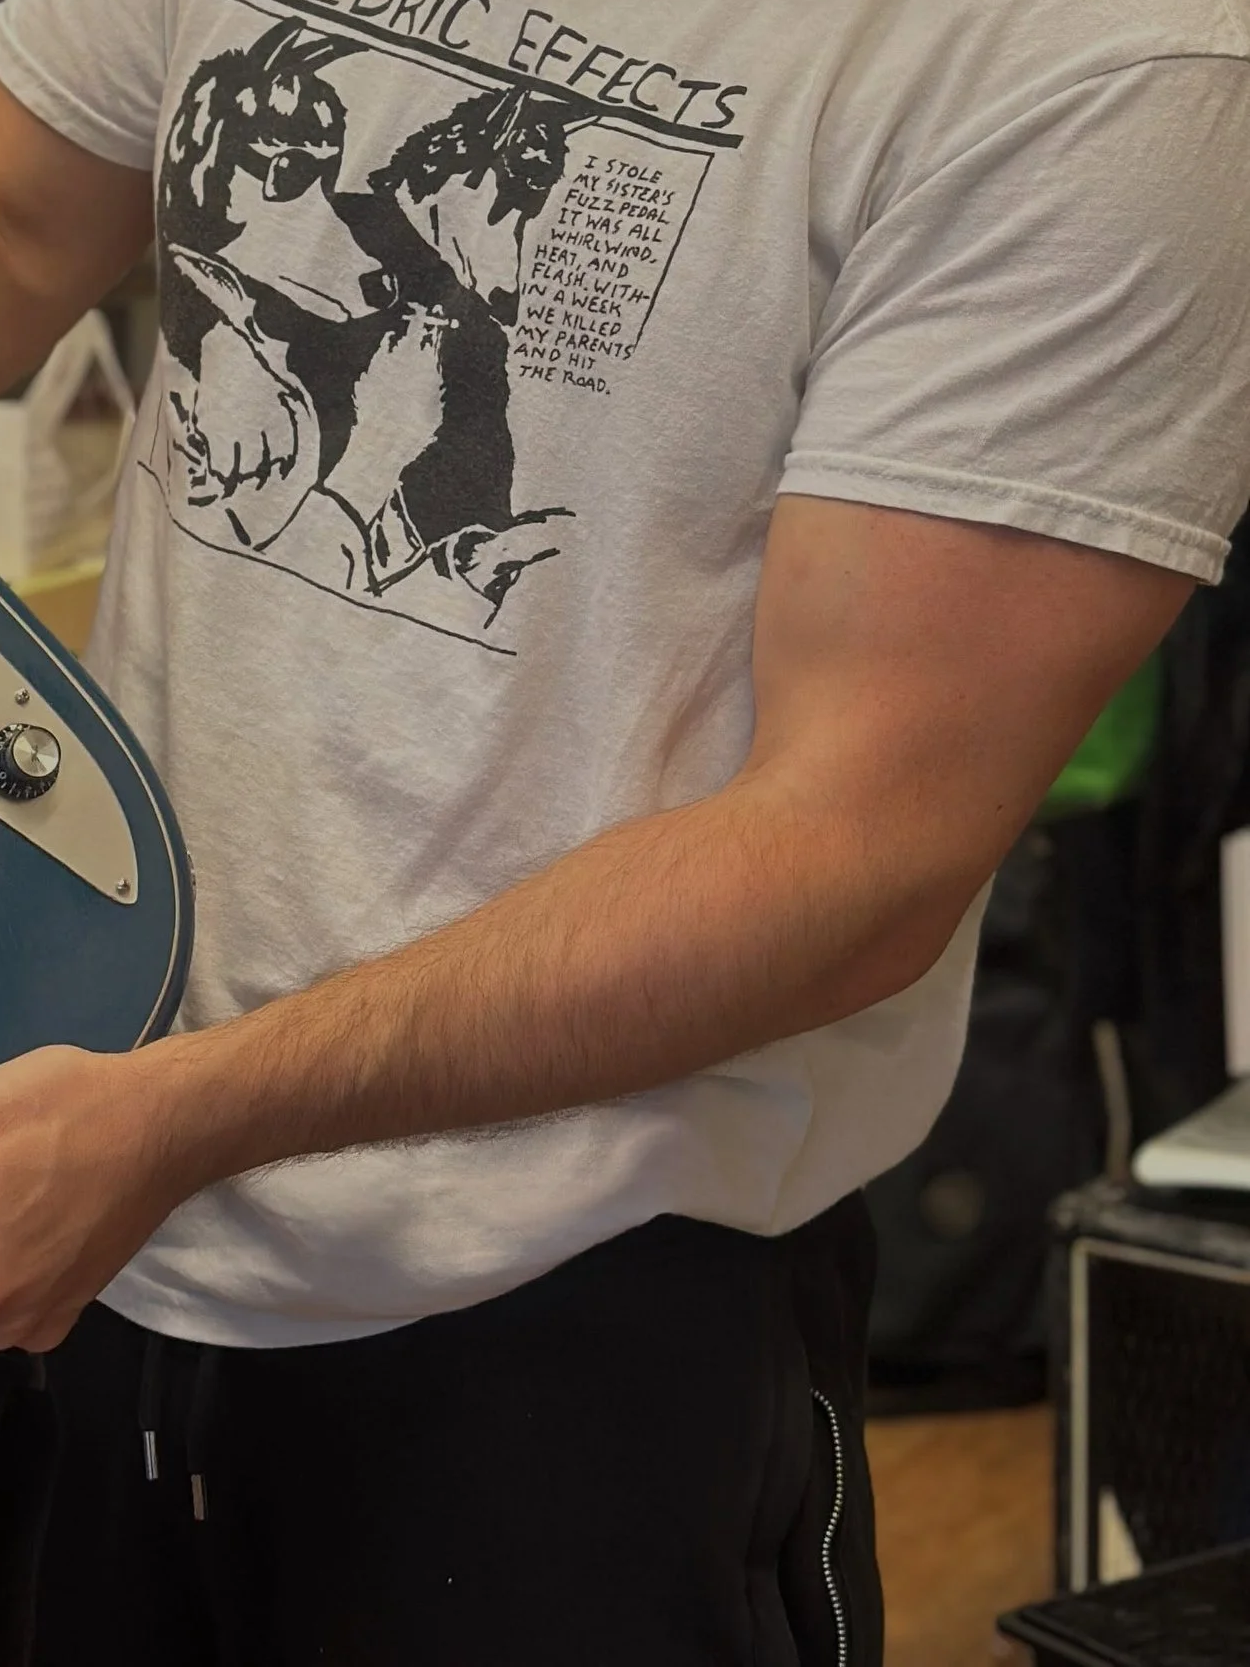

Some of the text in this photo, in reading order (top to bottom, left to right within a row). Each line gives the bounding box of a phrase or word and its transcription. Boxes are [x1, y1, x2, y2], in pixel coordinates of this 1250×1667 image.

[508, 9, 748, 129] EFFECTS
[585, 155, 663, 184] I STOLE
[564, 189, 670, 225] FUZZ PEDAL
[573, 173, 675, 206] MY SISTER'S
[558, 207, 662, 243] IT WAS ALL
[535, 244, 629, 279] HEAT, AND
[551, 228, 658, 264] WHIRLWIND,
[531, 262, 650, 303] FLASH. WITH-
[521, 283, 622, 318] IN A WEEK
[527, 306, 622, 337] WE KILLED
[513, 343, 597, 370] AND HIT
[515, 324, 636, 361] MY PARENTS
[519, 365, 611, 396] THE ROAD.
